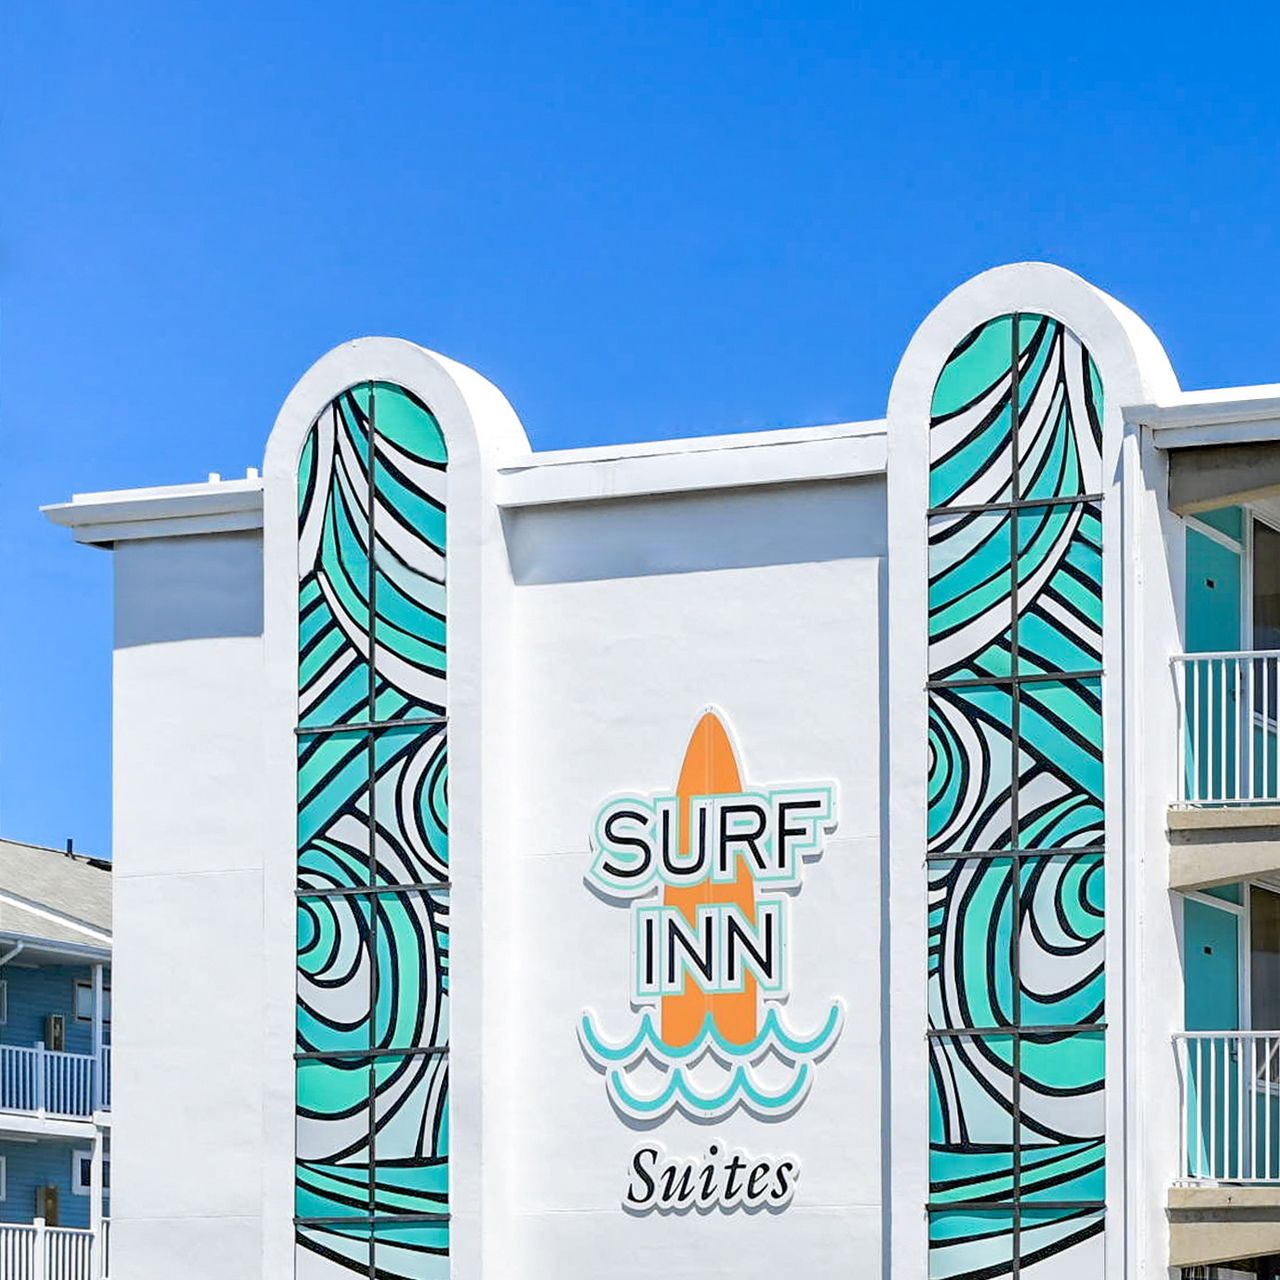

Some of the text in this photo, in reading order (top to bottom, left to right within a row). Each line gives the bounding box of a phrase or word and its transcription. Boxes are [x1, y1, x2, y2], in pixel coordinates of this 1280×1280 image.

[602, 799, 822, 879] SURF
[644, 912, 774, 985] INN
[627, 1144, 795, 1205] Suites
